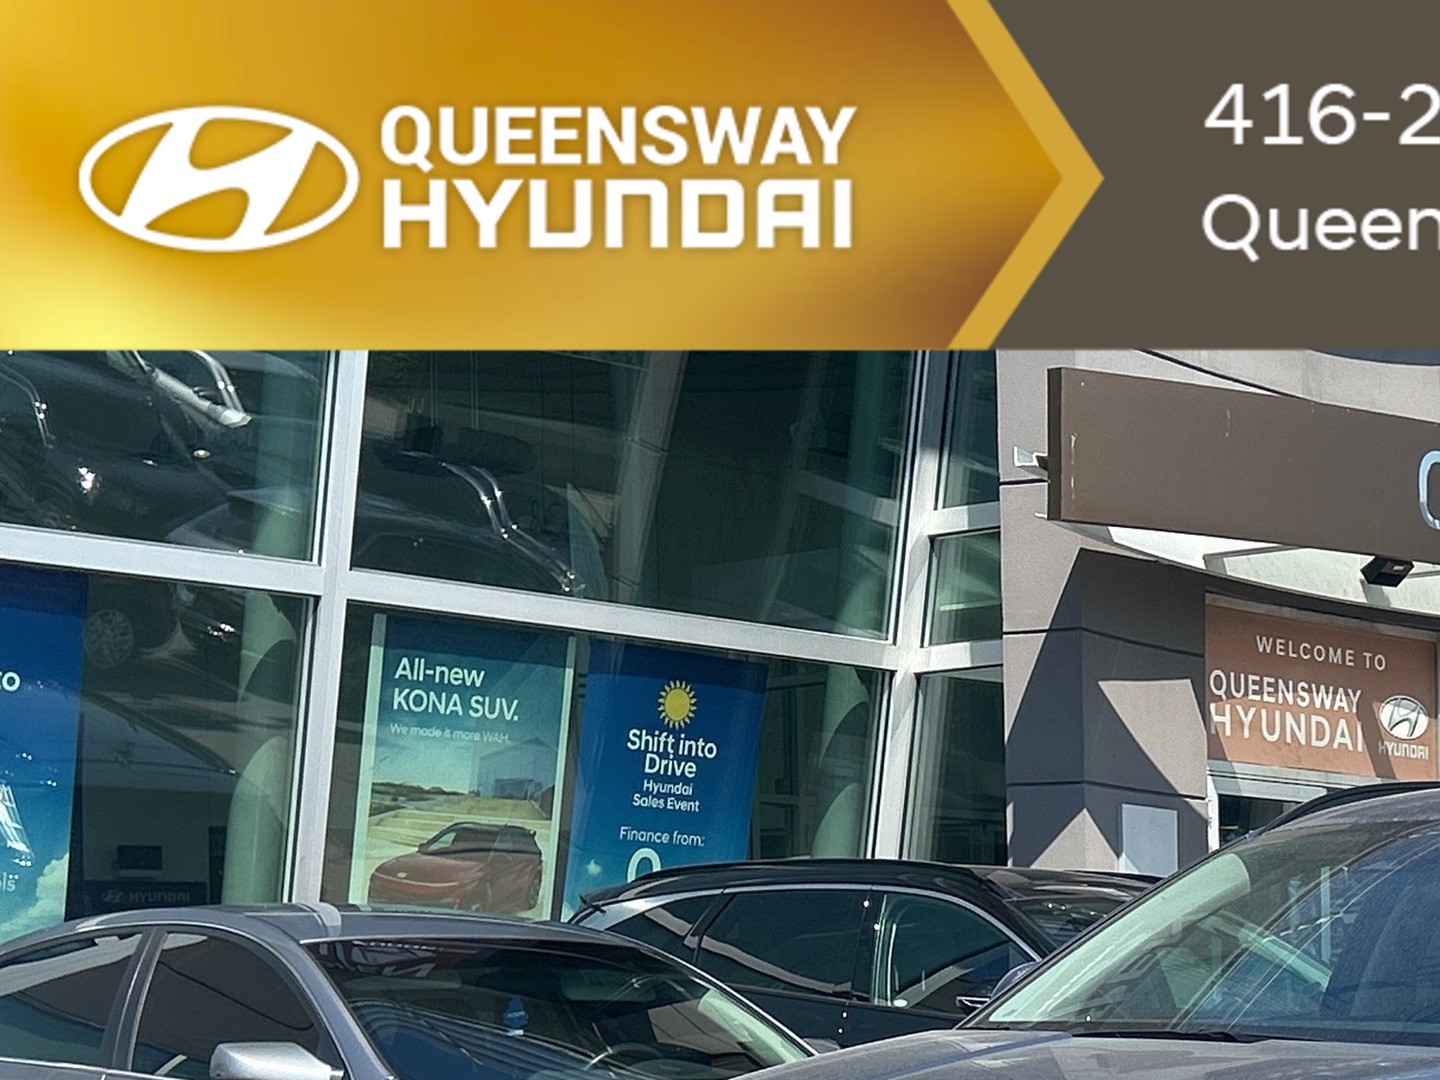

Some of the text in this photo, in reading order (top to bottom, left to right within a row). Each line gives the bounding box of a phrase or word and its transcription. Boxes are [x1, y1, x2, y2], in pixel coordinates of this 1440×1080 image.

[1256, 635, 1386, 671] WELCOME TO
[394, 657, 485, 687] All-new
[393, 687, 519, 722] KONA SUV.
[1209, 669, 1362, 714] QUEENSWAY
[1210, 702, 1363, 752] HYUNDAI
[627, 729, 717, 759] Shift into
[1379, 740, 1429, 760] HYUNDAI
[644, 753, 697, 778] Drive
[643, 779, 694, 796] Hyundai
[632, 794, 700, 812] Sales Event
[619, 826, 670, 844] Finance
[129, 891, 191, 902] HYUNDAI
